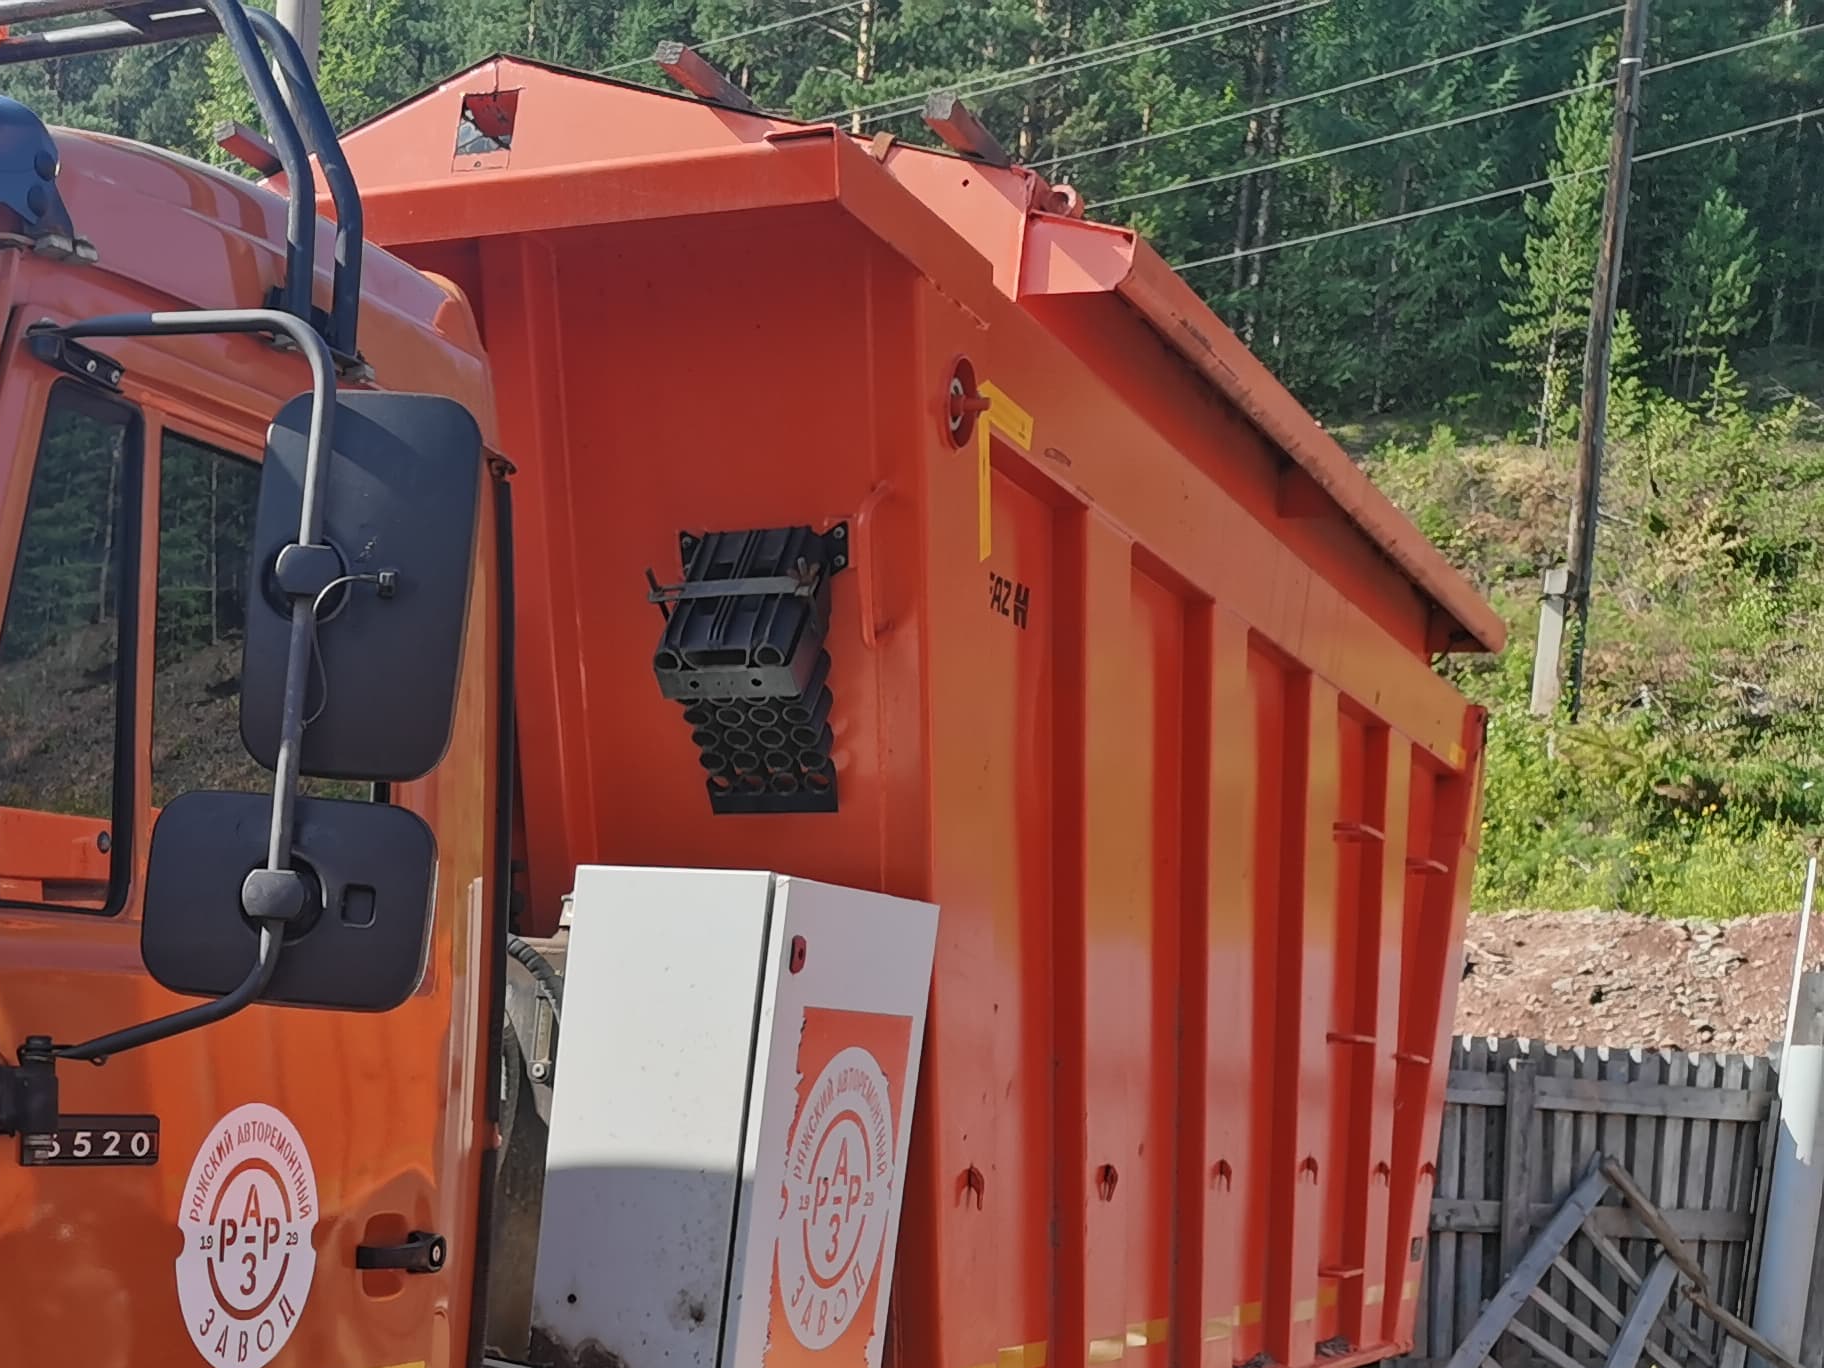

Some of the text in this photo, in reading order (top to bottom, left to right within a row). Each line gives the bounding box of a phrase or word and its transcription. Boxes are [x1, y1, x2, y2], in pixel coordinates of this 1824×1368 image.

[189, 1121, 313, 1222] РЯЖСКИЙ АВТОРЕМОНТНЫЙ
[199, 1235, 214, 1251] 19
[286, 1231, 299, 1246] 29
[199, 1294, 296, 1363] ЗАВОД
[791, 1261, 866, 1337] ЗАВОД
